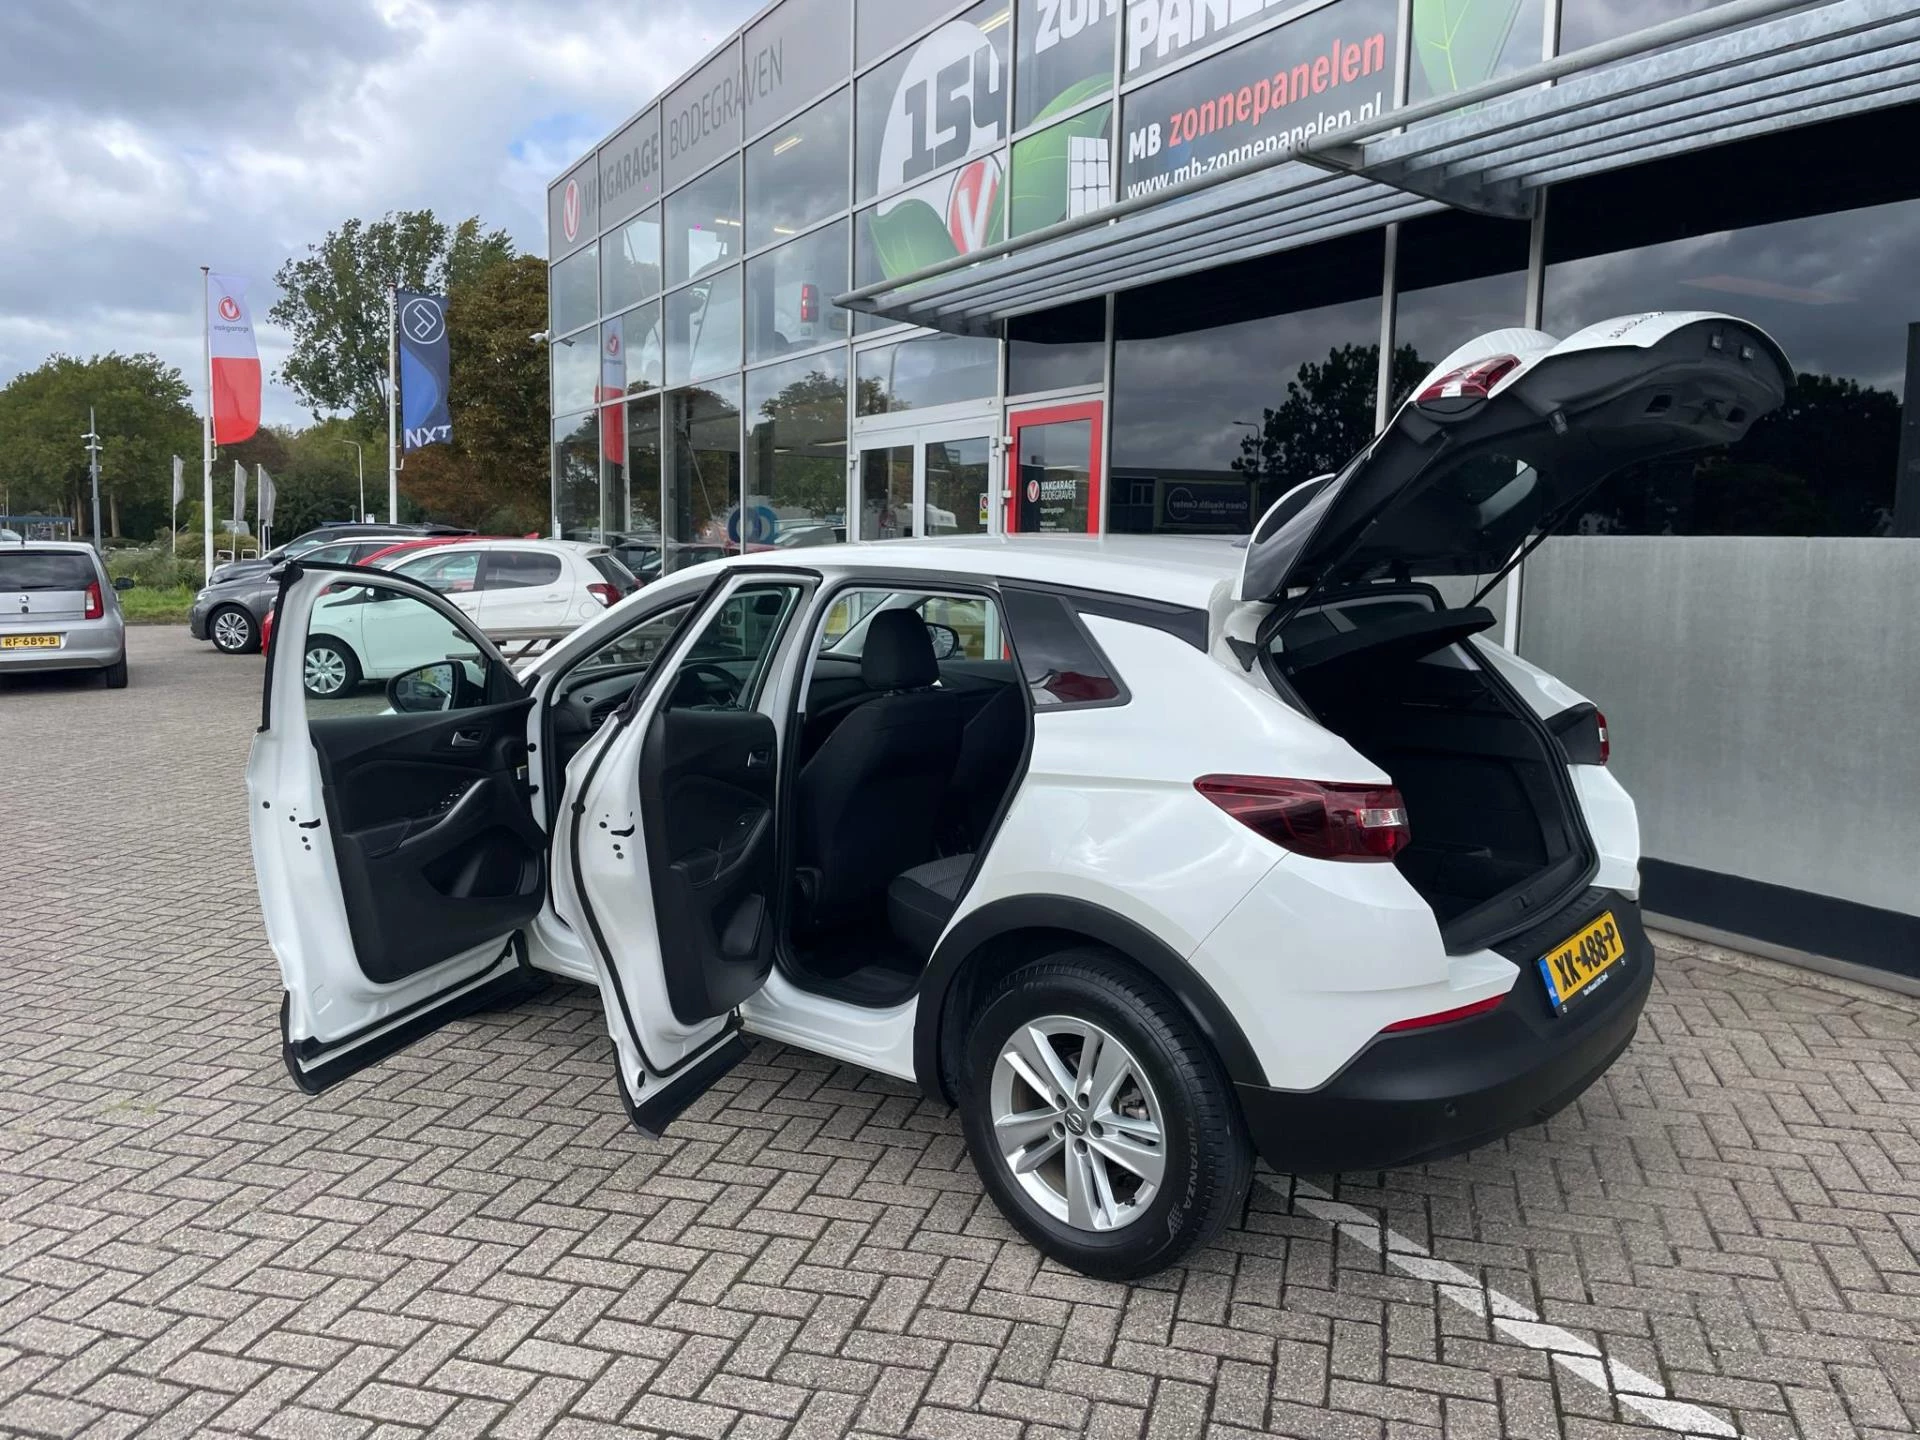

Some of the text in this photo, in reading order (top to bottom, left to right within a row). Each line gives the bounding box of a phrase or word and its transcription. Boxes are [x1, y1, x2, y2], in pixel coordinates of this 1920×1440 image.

[584, 132, 659, 218] VAKGARAGE
[670, 38, 782, 160] BODEGRAVEN
[902, 42, 1008, 184] 154
[1128, 33, 1385, 163] MB zonnepanelen
[1127, 92, 1382, 199] www.mb-zonnepanelen.nl
[405, 425, 452, 449] NXT
[1041, 480, 1076, 490] VAKGARAGE
[1041, 488, 1076, 500] BODEGRAVEN
[5, 636, 57, 647] RF-689-B
[1554, 921, 1616, 992] XK-488-P
[1184, 1115, 1199, 1209] TURANZA
